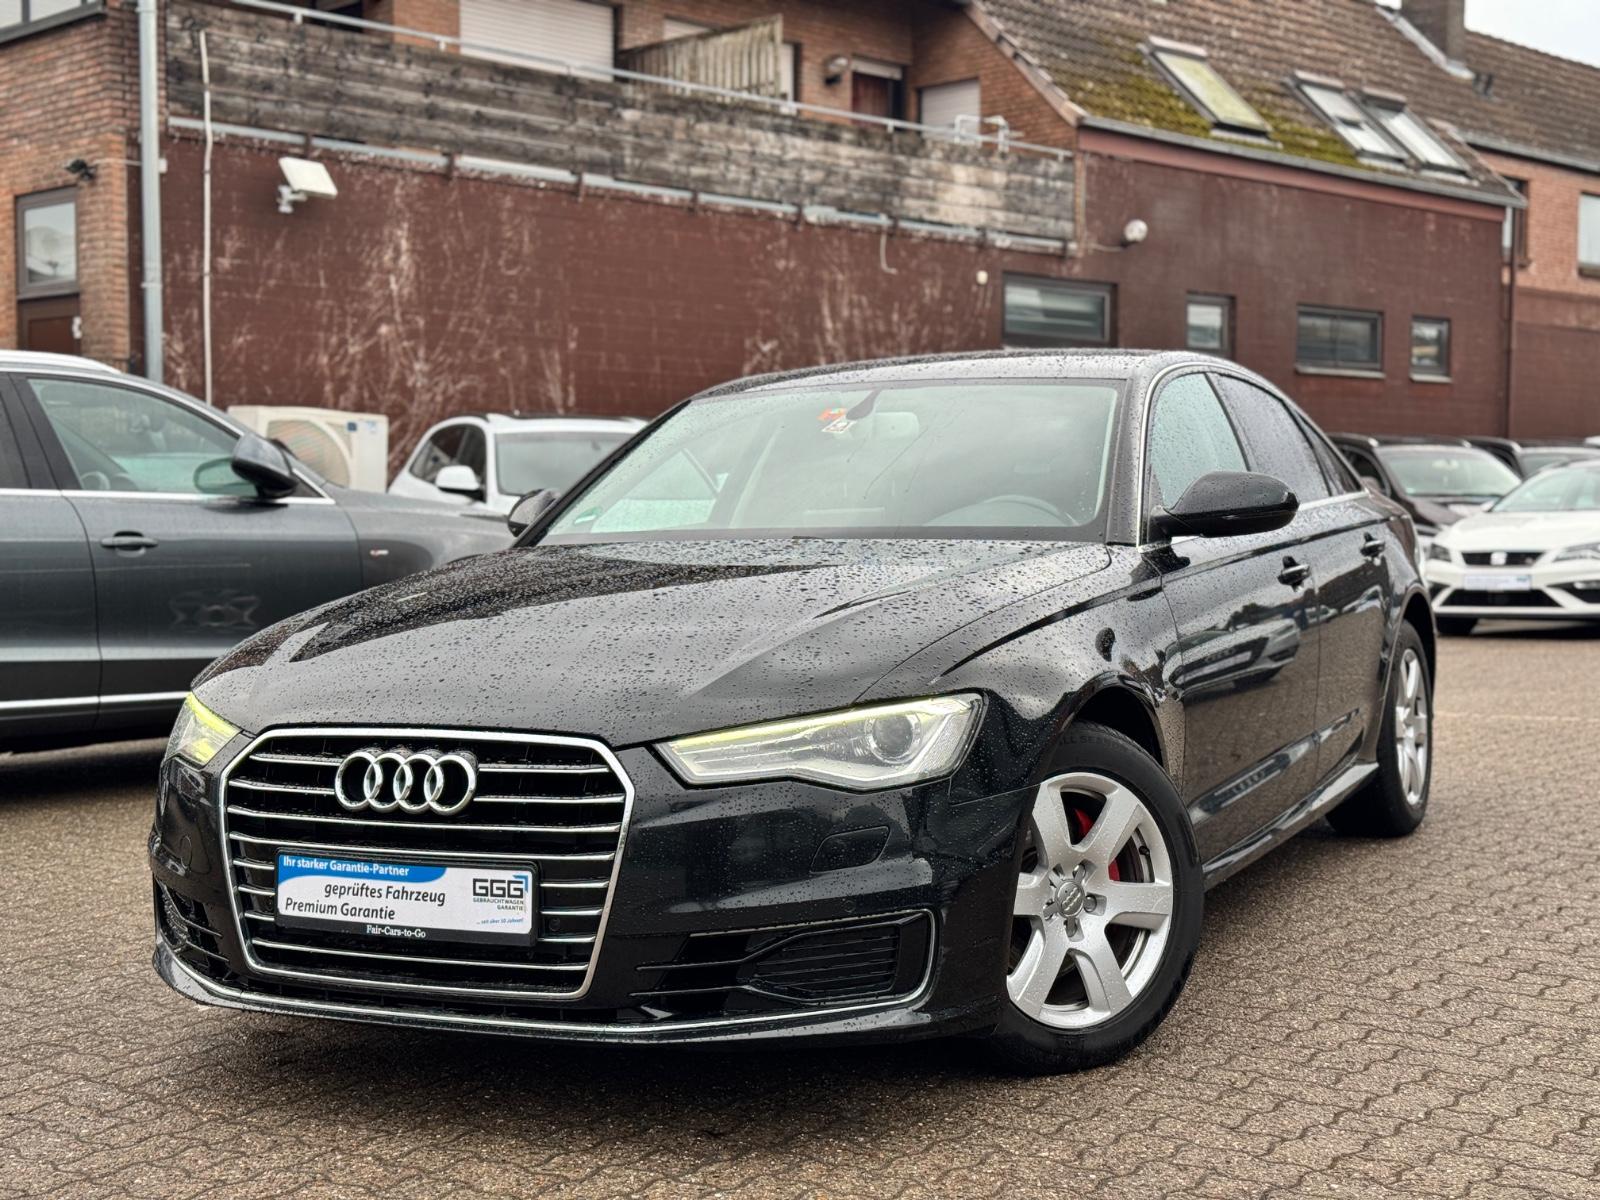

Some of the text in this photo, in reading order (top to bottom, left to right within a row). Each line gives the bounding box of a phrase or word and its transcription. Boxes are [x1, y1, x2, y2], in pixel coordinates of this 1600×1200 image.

[283, 857, 410, 876] Ihr starker Garantie-Partner
[324, 883, 446, 906] geprüftes Fahrzeug
[472, 878, 524, 899] GGG
[286, 897, 395, 920] Premium Garantie
[473, 897, 524, 905] GEBRAUCHTWAGEN
[366, 925, 426, 938] Fair-Cars-to-Go
